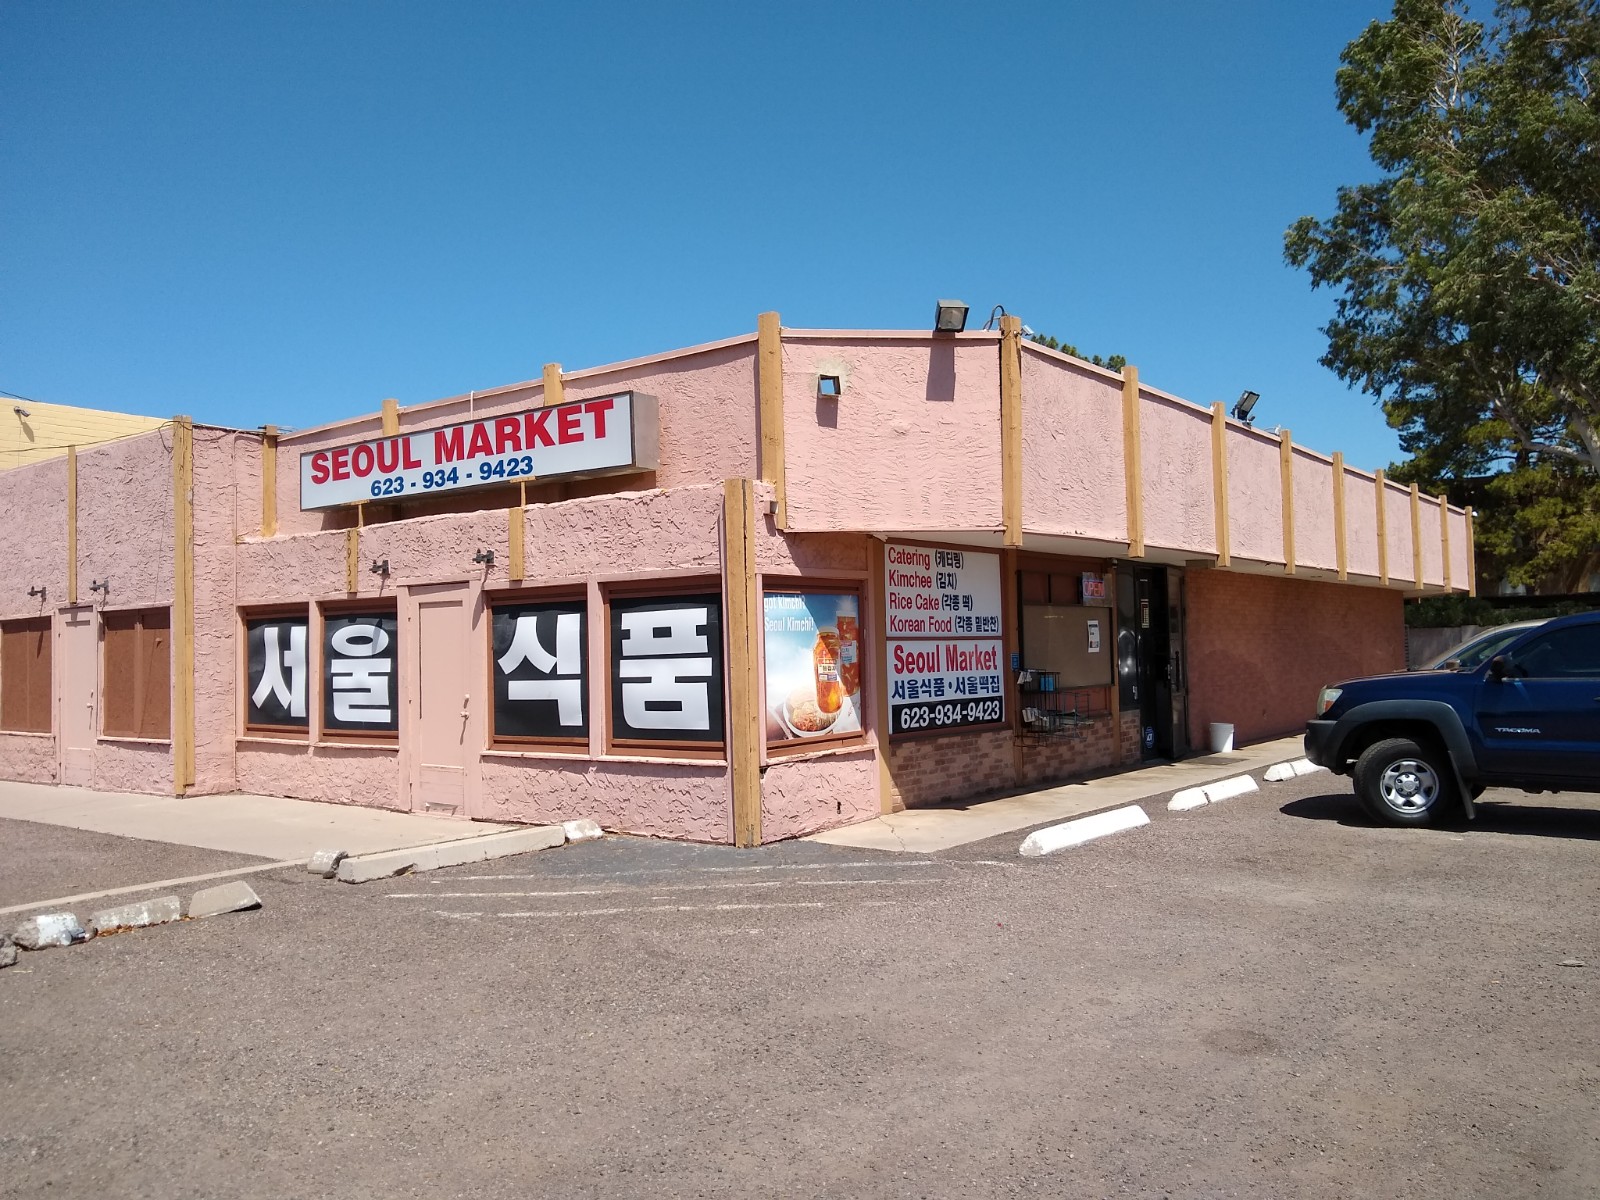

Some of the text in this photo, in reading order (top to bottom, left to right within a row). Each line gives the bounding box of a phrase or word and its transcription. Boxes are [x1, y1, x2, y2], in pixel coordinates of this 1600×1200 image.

[311, 398, 614, 485] SEOUL MARKET
[370, 475, 404, 497] 623
[422, 466, 459, 490] 934
[479, 455, 534, 482] 9423
[888, 546, 930, 570] Catering
[888, 569, 957, 590] Kimchee (김치)
[1083, 581, 1105, 597] OPEN
[889, 592, 912, 610] Rice
[915, 593, 939, 611] Cake
[764, 616, 785, 632] Seoul
[889, 615, 925, 633] Korean
[928, 615, 952, 633] Food
[893, 644, 998, 675] Seoul Market
[900, 700, 1000, 729] 623-934-9423
